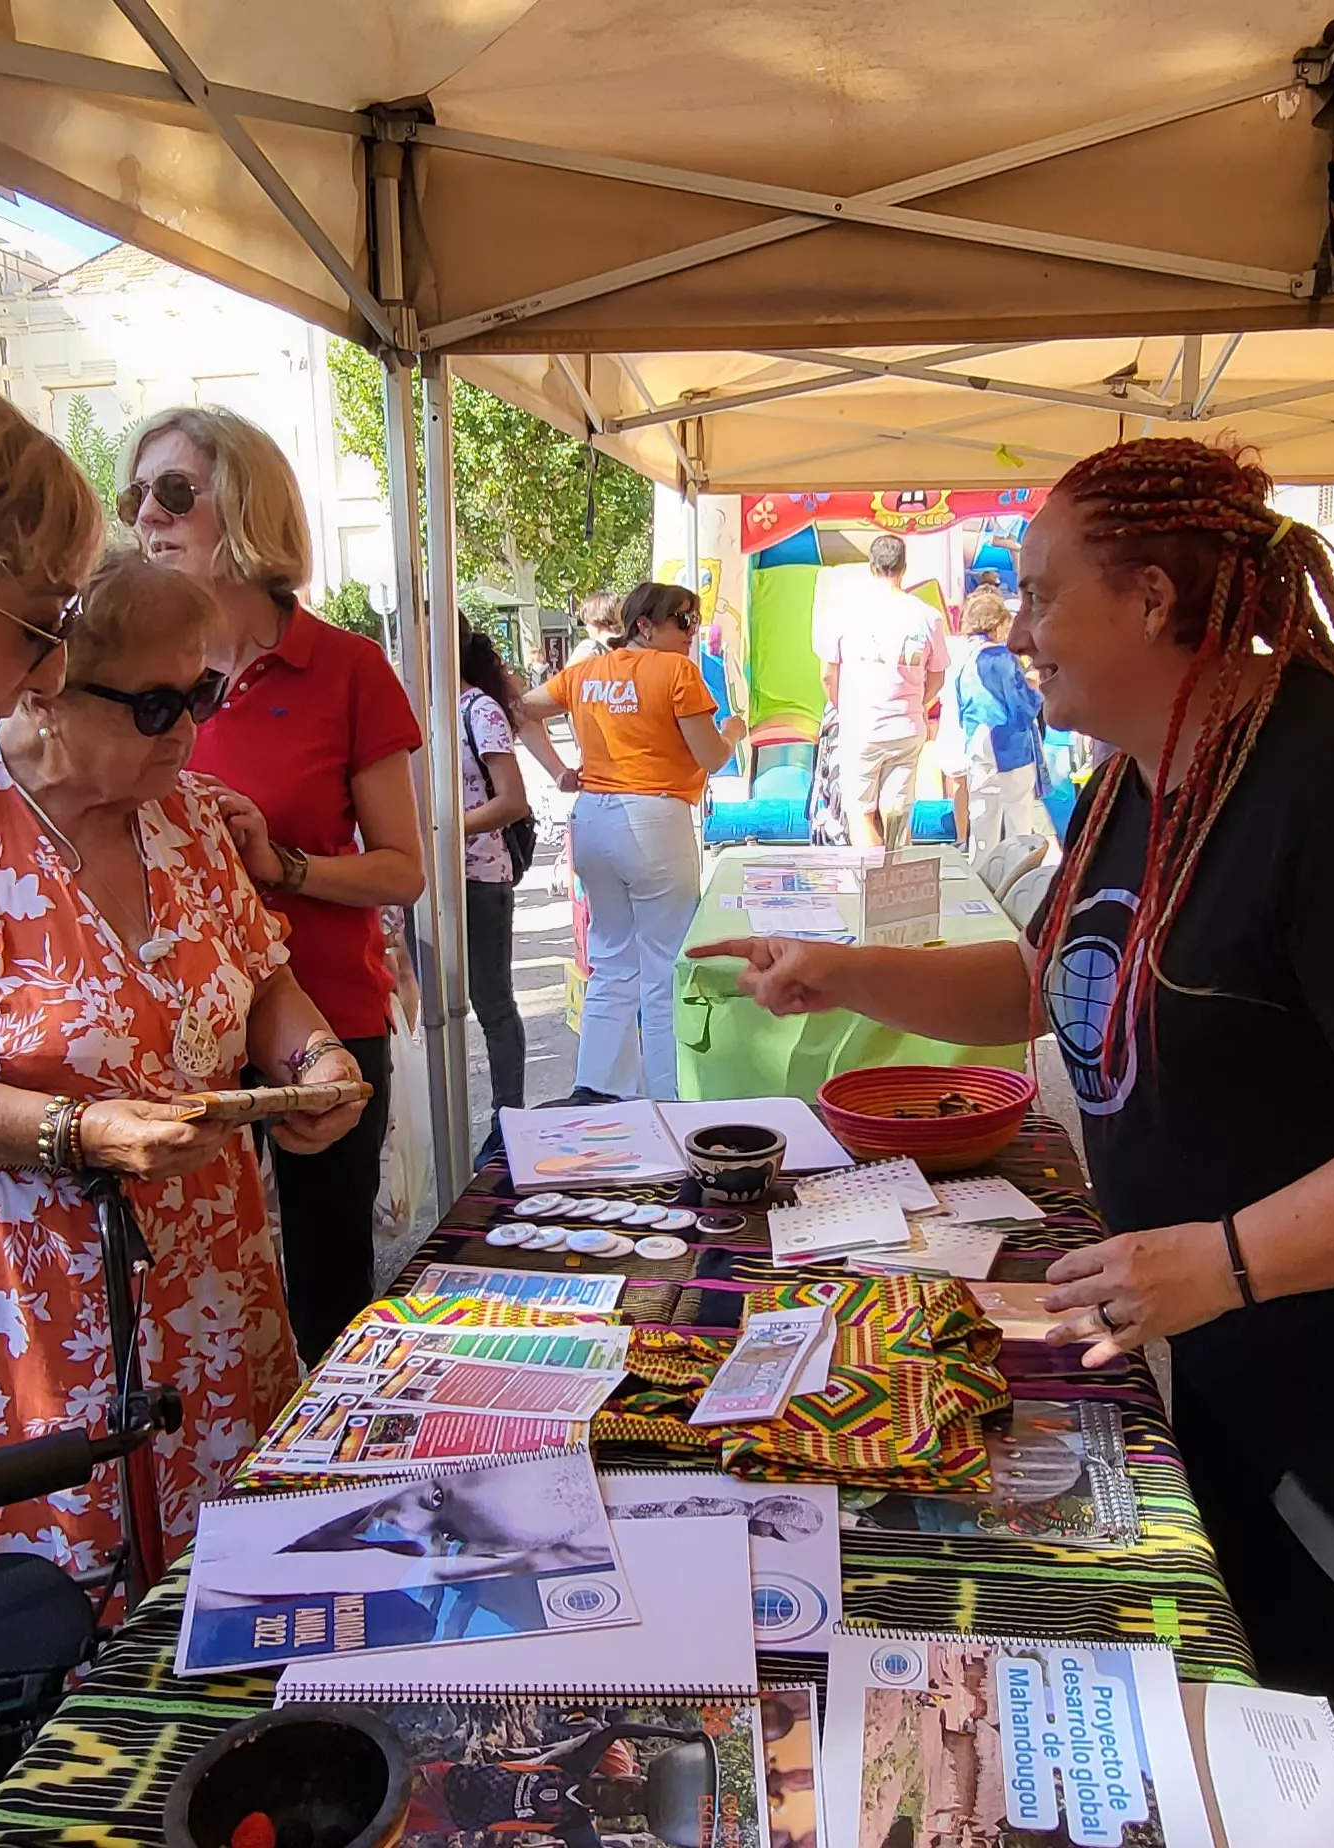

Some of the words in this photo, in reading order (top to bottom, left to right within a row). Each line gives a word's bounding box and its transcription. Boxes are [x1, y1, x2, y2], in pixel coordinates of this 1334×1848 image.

[582, 680, 638, 704] YMCA
[609, 704, 638, 714] CAMPS
[253, 1614, 288, 1648] 2022
[294, 1608, 326, 1648] ANUAL
[333, 1594, 365, 1652] MEMORIA
[1061, 1657, 1095, 1764] desarrollo
[1007, 1667, 1039, 1819] Mahandougou
[1041, 1732, 1066, 1758] de
[1090, 1685, 1124, 1780] Proyecto
[1108, 1783, 1132, 1810] de
[1069, 1767, 1108, 1836] global
